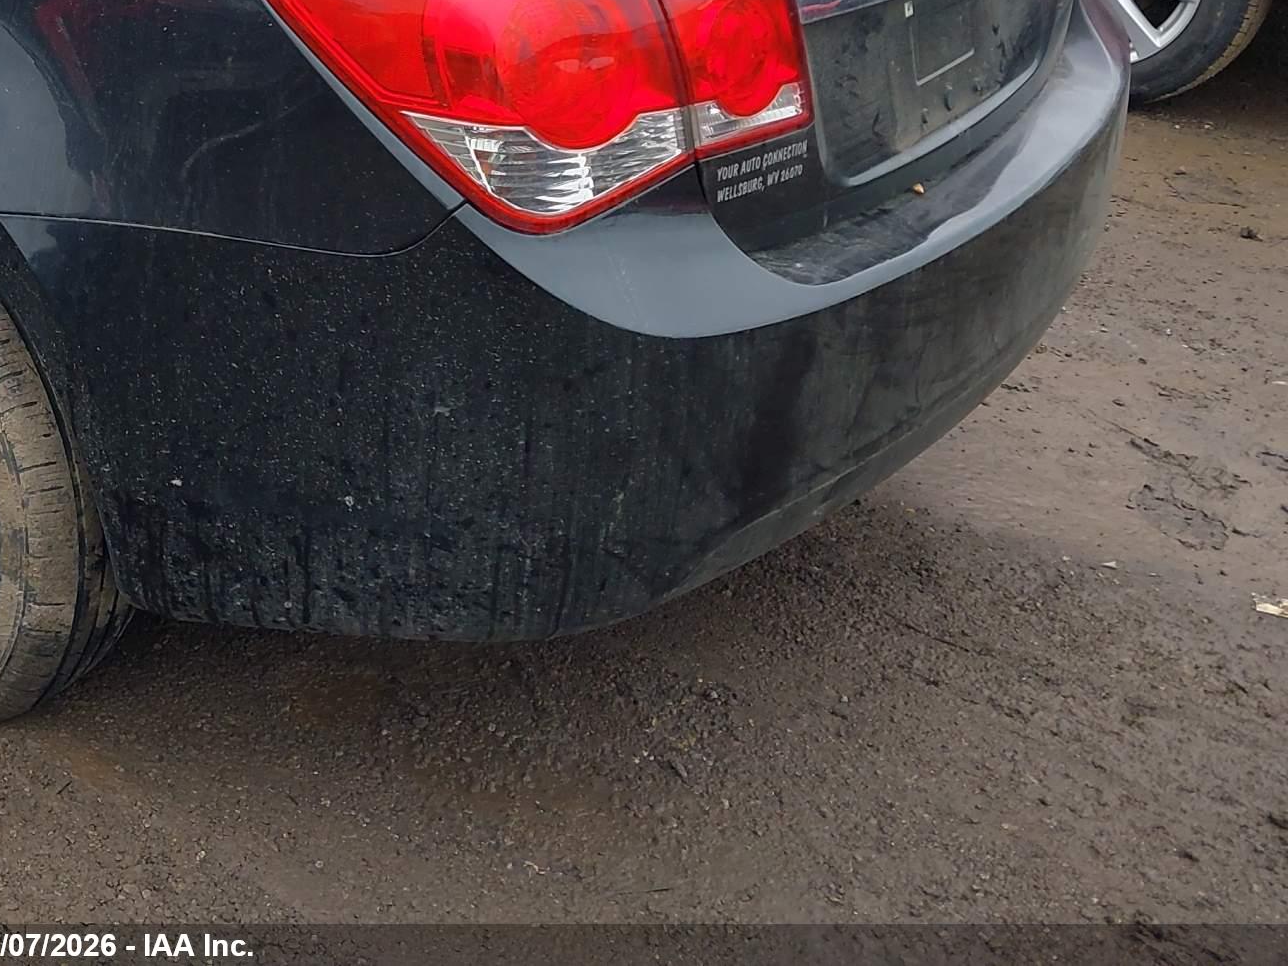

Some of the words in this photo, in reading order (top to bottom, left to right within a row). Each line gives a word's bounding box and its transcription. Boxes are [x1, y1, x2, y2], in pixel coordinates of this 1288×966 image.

[717, 163, 740, 182] YOUR
[740, 156, 761, 176] AUTO
[762, 139, 808, 170] CONNECTION
[717, 176, 765, 203] WELLSBURG,
[767, 170, 780, 187] WV
[780, 164, 804, 182] 26070
